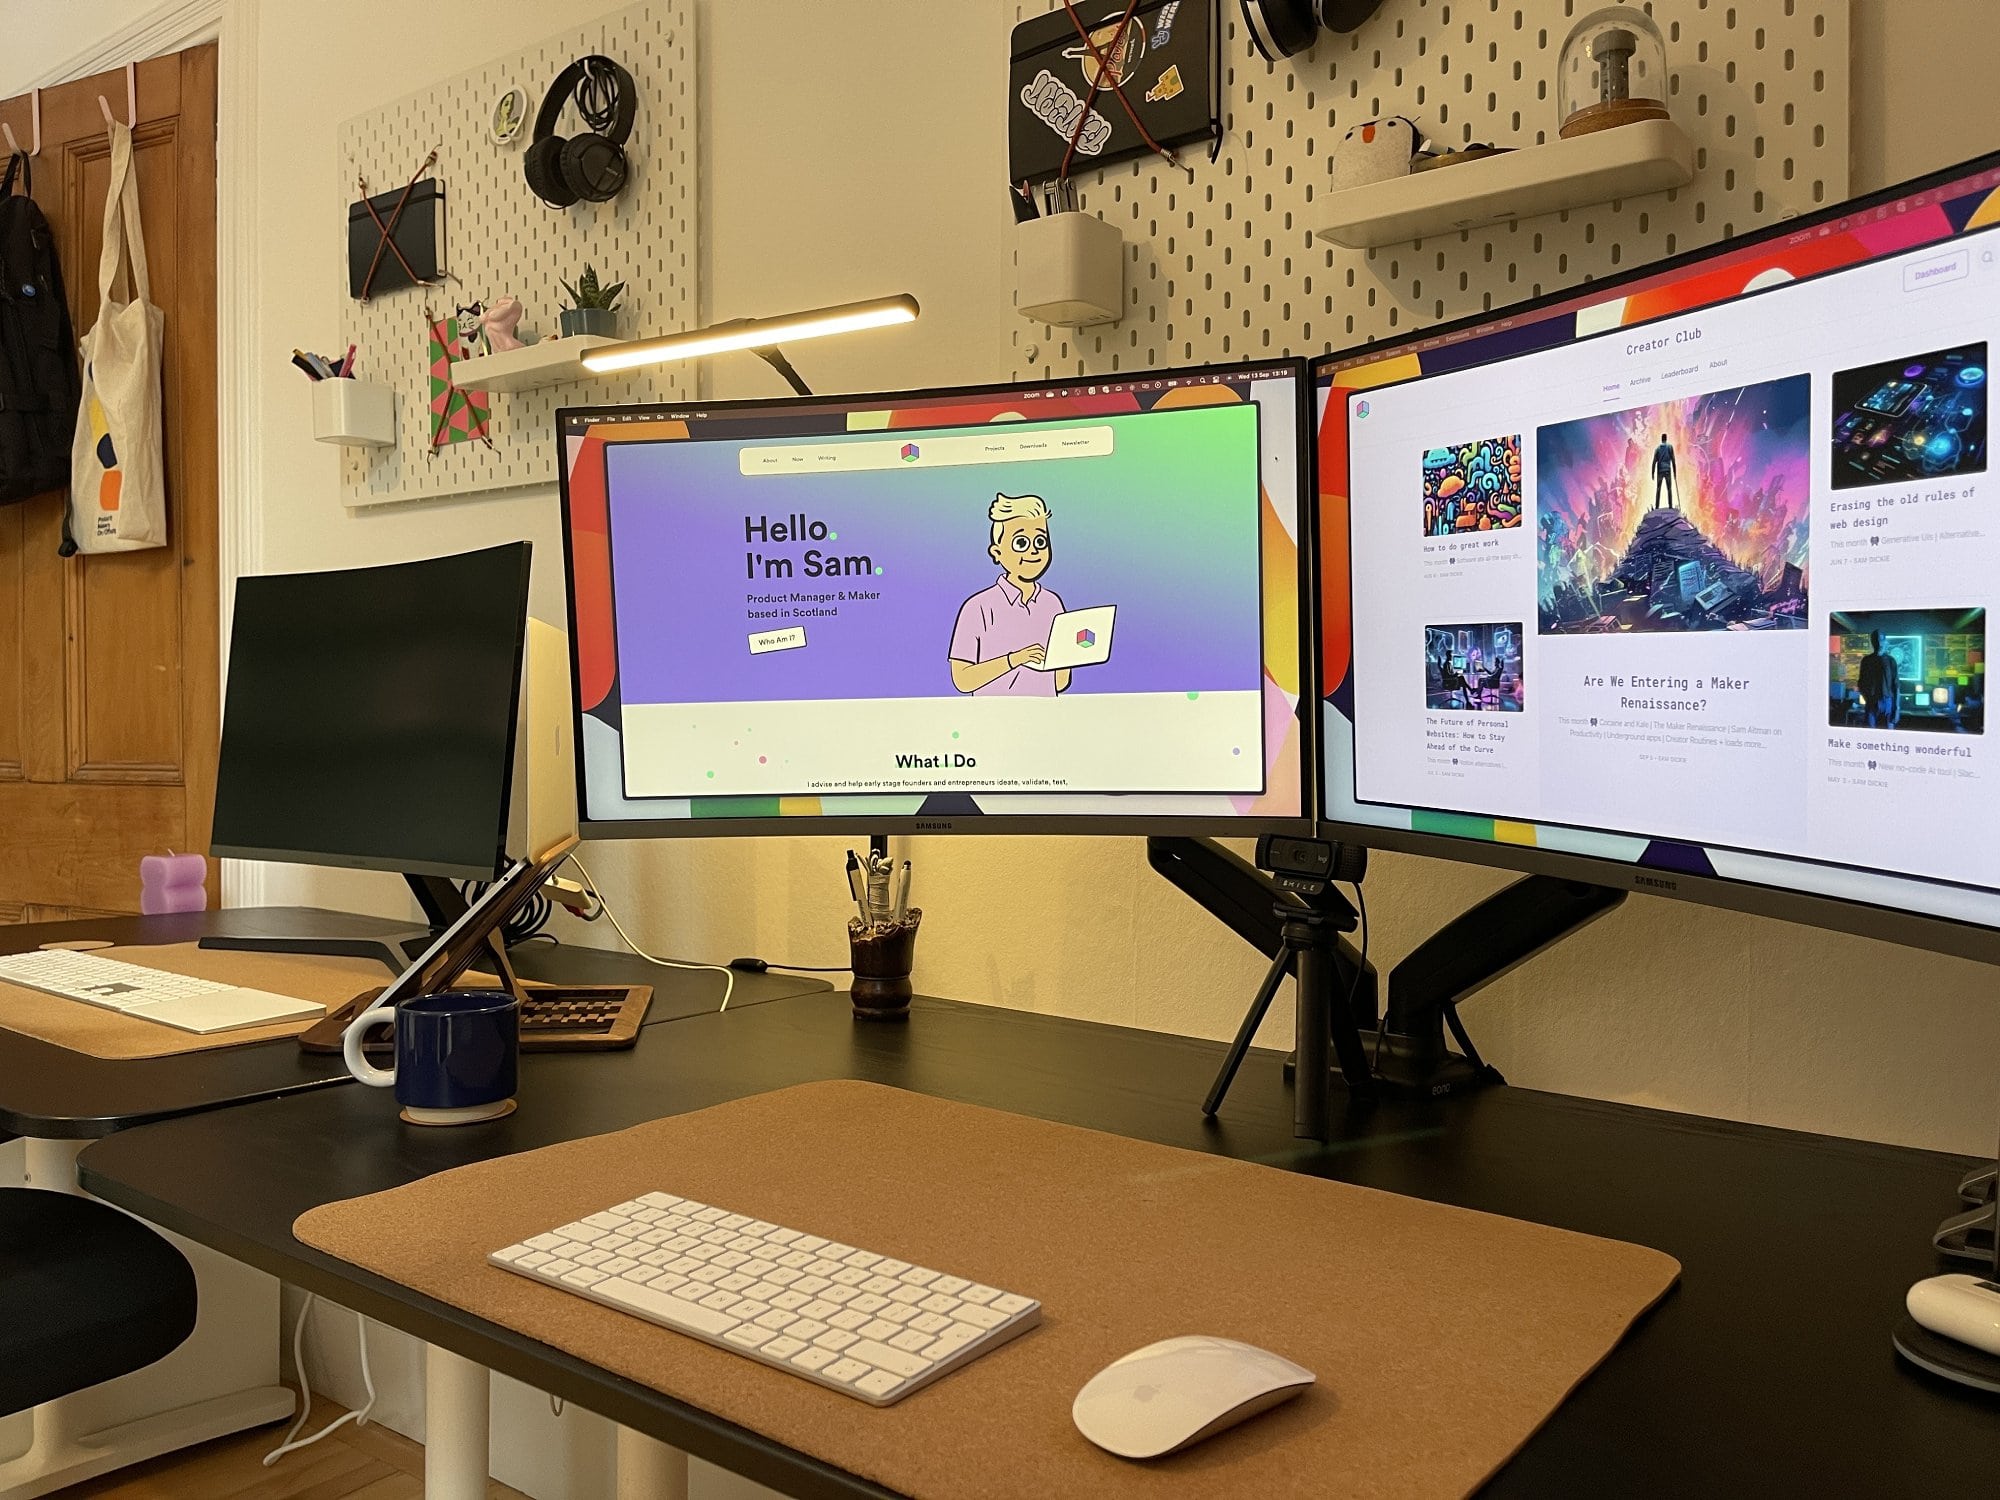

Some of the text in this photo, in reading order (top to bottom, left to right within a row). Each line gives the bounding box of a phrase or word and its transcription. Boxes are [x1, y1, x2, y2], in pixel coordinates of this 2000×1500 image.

[1914, 262, 1957, 280] Dashboard
[1501, 320, 1512, 328] Help
[1626, 328, 1702, 356] Creator Club
[1603, 359, 1728, 392] Home Archive Leaderboard About
[1023, 392, 1040, 400] zoom
[584, 416, 600, 424] Finder
[638, 414, 650, 422] View
[670, 412, 690, 420] Window
[696, 412, 708, 420] Help
[984, 438, 1090, 453] Projects Downloads Newsletter
[818, 454, 837, 463] Writing
[1830, 487, 1975, 512] Erasing the old rules of
[745, 513, 838, 543] Hello.
[1830, 516, 1888, 530] web design
[1438, 544, 1446, 552] to
[1460, 542, 1480, 551] great
[1483, 538, 1499, 546] work
[746, 550, 884, 580] I'm Sam.
[747, 590, 880, 604] Product Manager & Maker
[748, 606, 838, 619] based in Scotland
[758, 638, 776, 646] Who
[776, 636, 788, 644] Am
[1584, 675, 1750, 690] Are We Entering a Maker
[1621, 697, 1707, 712] Renaissance?
[1440, 718, 1464, 726] Future
[1478, 720, 1508, 728] Personal
[1654, 720, 1666, 729] The
[1666, 722, 1686, 730] Maker
[1731, 725, 1746, 734] Sam
[1773, 728, 1782, 736] on
[1426, 730, 1460, 738] Websites:
[1490, 734, 1506, 742] Stay
[1570, 729, 1602, 739] Productivity
[1606, 731, 1645, 741] Underground
[1474, 746, 1494, 754] Curve
[1828, 738, 1972, 758] Make something wonderful
[895, 754, 977, 768] What I Do
[834, 780, 847, 788] and
[848, 780, 863, 789] help
[864, 780, 882, 788] early
[882, 780, 901, 788] stage
[948, 780, 996, 788] entrepreneurs
[916, 822, 952, 830] SAMSUNG
[1634, 876, 1677, 890] SAMSUNG
